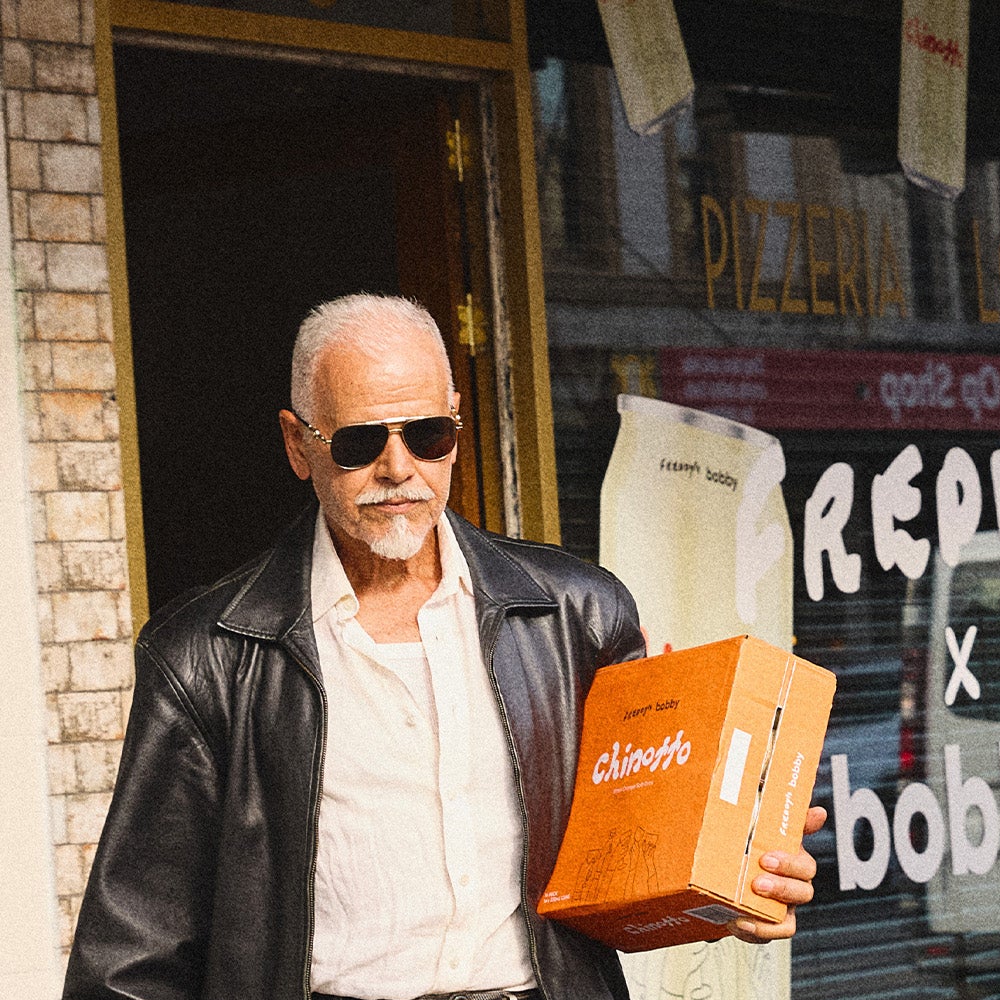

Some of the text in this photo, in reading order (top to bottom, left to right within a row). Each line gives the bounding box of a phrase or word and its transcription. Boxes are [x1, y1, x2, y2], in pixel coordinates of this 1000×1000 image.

[700, 195, 908, 317] PIZZERIA
[655, 699, 680, 712] bobby
[592, 729, 691, 785] Chinotto
[788, 752, 805, 788] bobby
